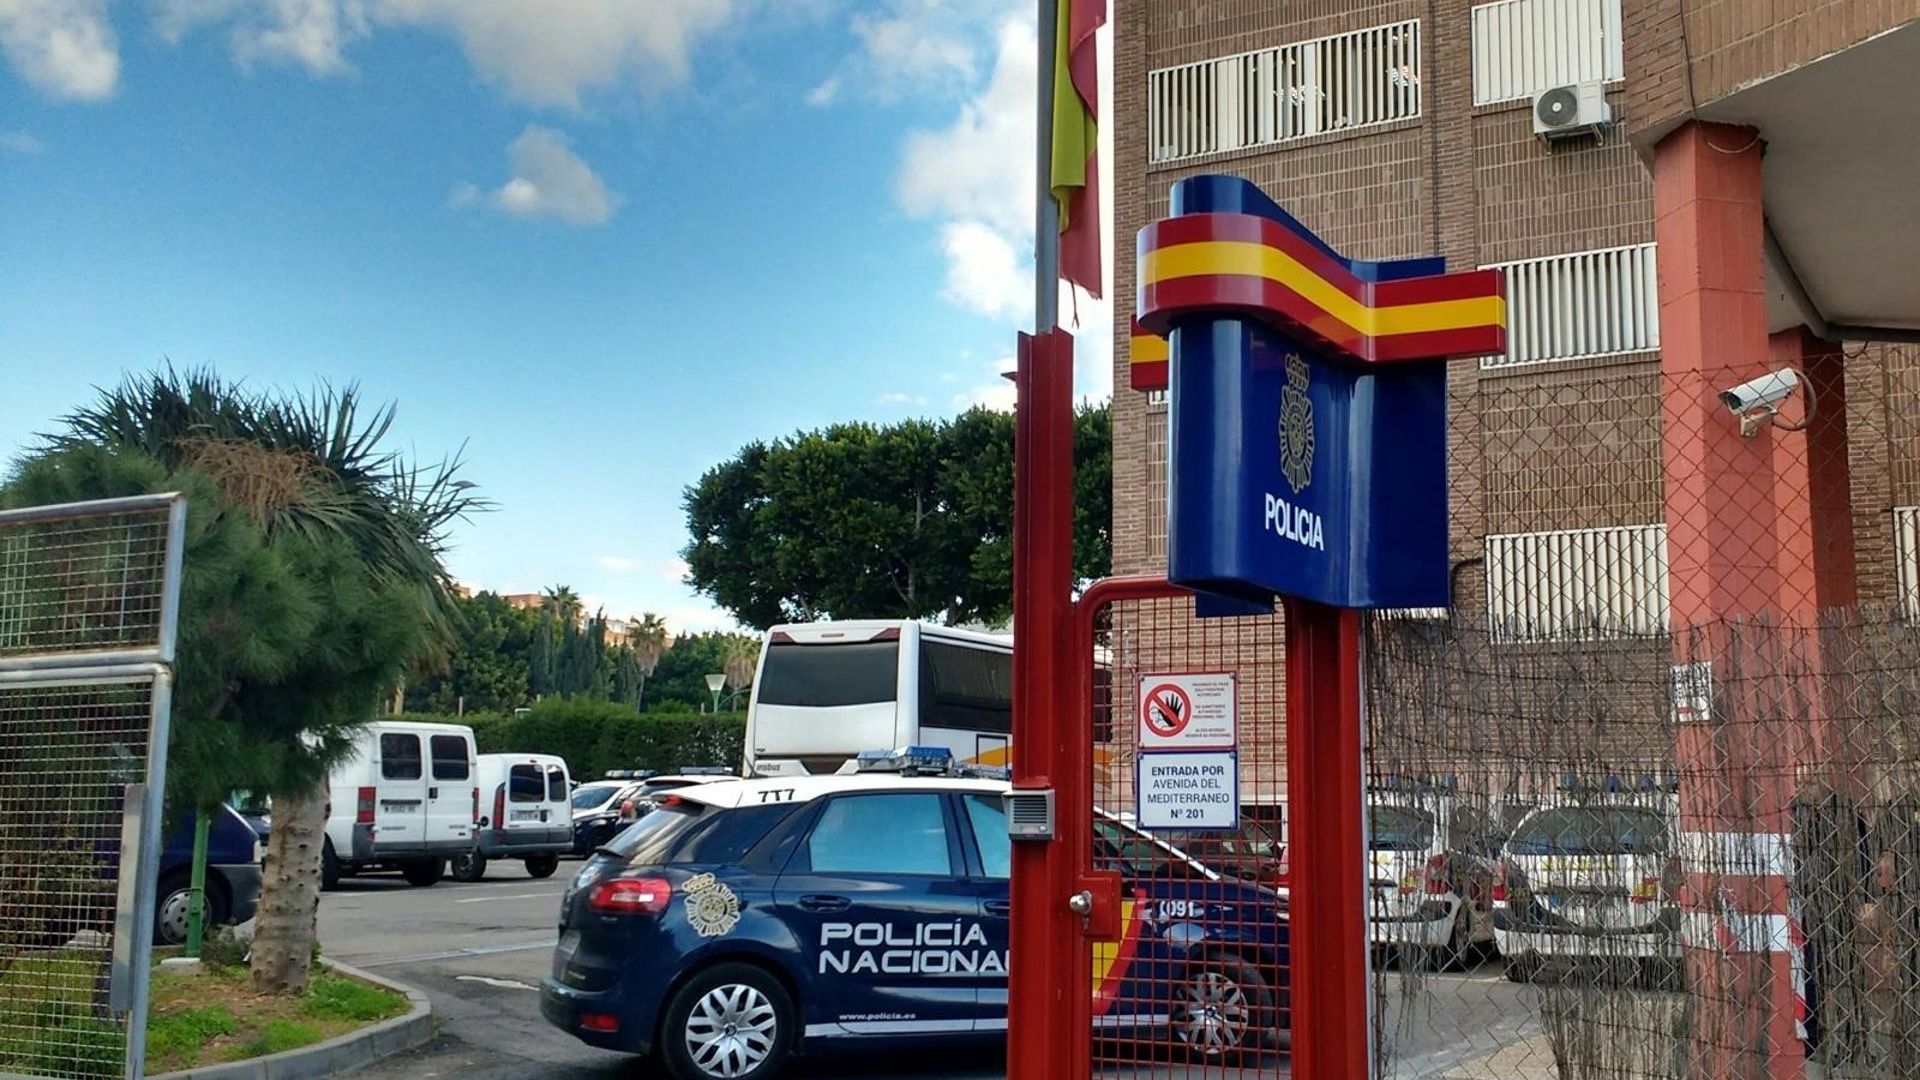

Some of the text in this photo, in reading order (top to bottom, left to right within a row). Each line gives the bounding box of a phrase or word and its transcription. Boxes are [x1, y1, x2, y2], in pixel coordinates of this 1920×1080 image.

[1265, 492, 1325, 551] POLICIA
[1151, 765, 1225, 776] ENTRADA POR
[1152, 778, 1222, 789] AVENIDA DEL
[1147, 792, 1230, 804] MEDITERRANEO
[1186, 808, 1205, 819] 201
[820, 918, 988, 946] POLICÍA
[838, 1012, 917, 1021] www.policia.es
